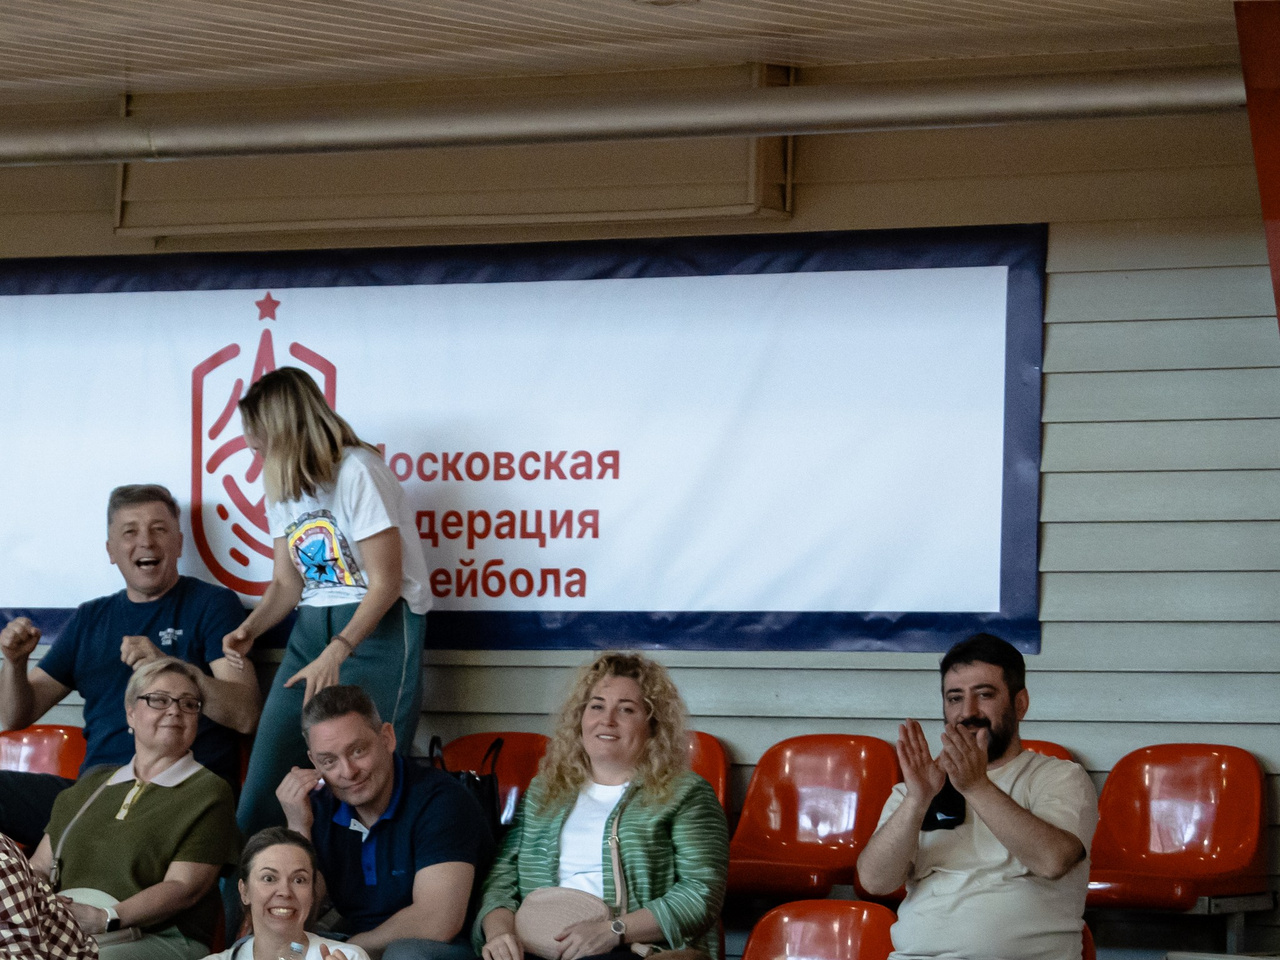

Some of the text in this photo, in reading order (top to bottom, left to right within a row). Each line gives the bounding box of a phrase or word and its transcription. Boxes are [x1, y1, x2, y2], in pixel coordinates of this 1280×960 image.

[376, 442, 621, 482] осковская
[414, 508, 600, 550] дерация
[429, 558, 587, 599] ейбола
